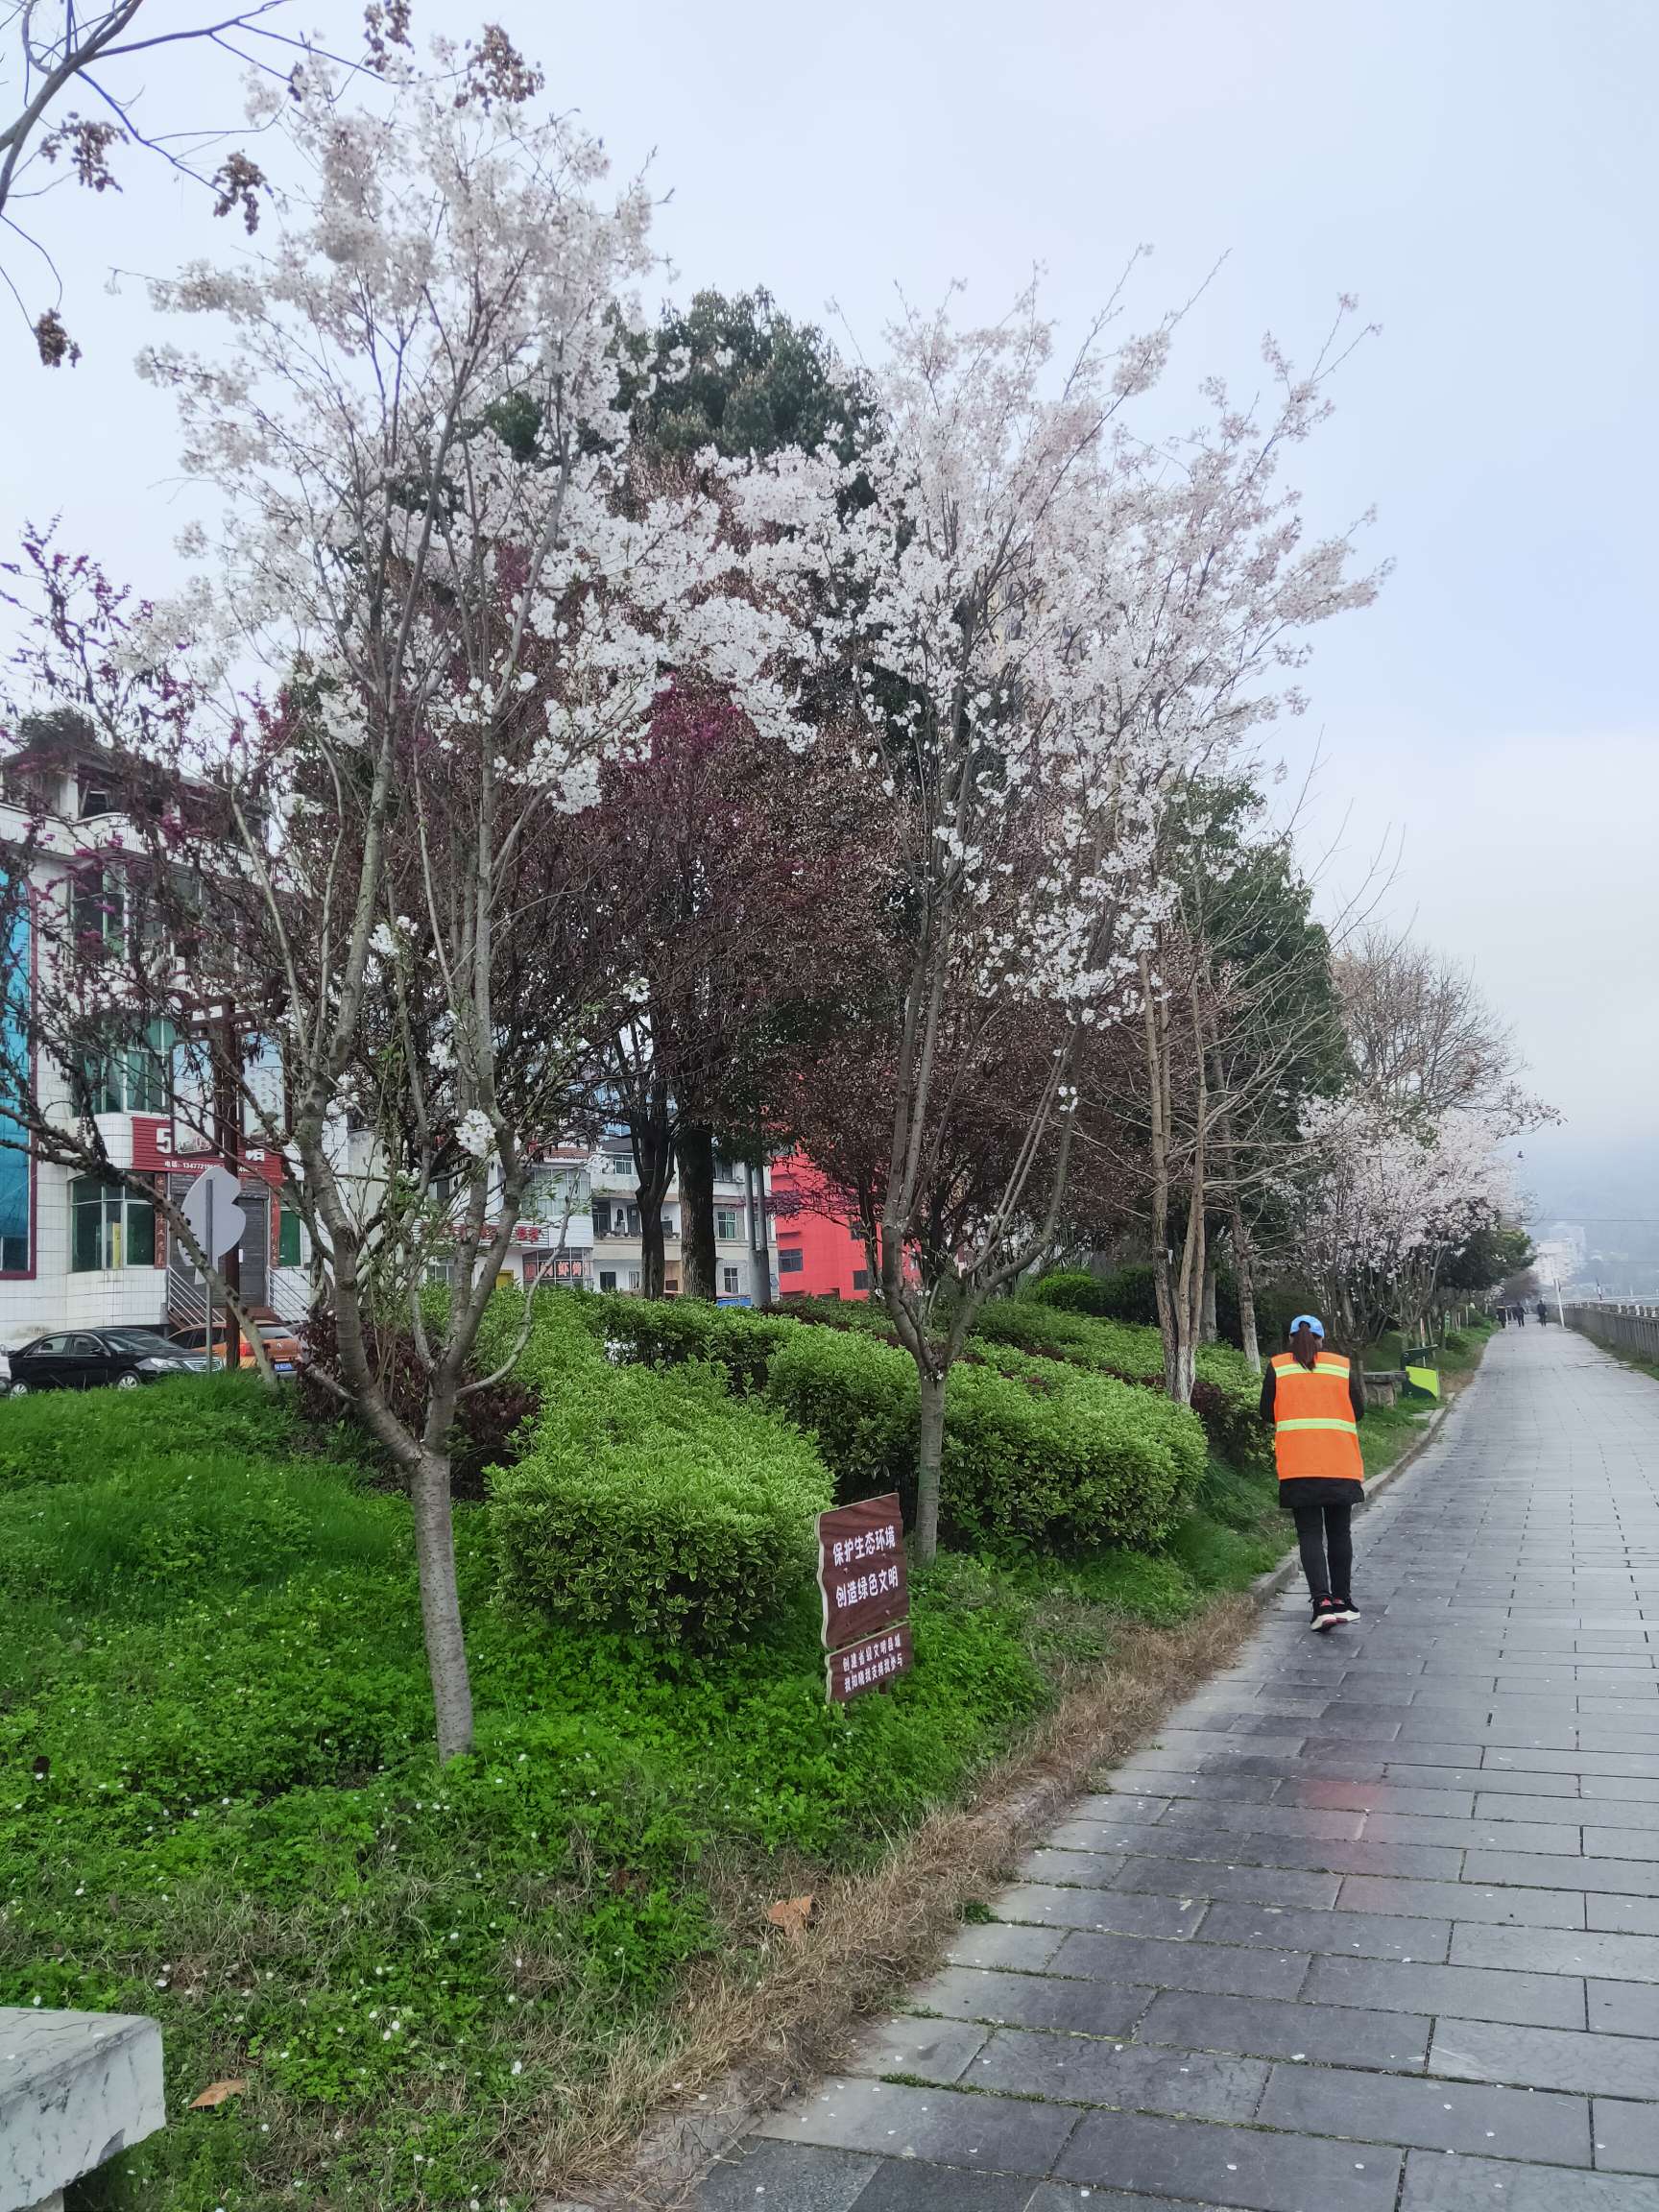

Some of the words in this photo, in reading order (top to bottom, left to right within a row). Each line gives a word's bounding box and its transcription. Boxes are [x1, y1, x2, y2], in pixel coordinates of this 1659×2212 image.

[832, 1525, 896, 1567] 保护生态环境
[835, 1565, 899, 1608] 创造绿色文明
[844, 1652, 902, 1694] 我知晓我支持我参与
